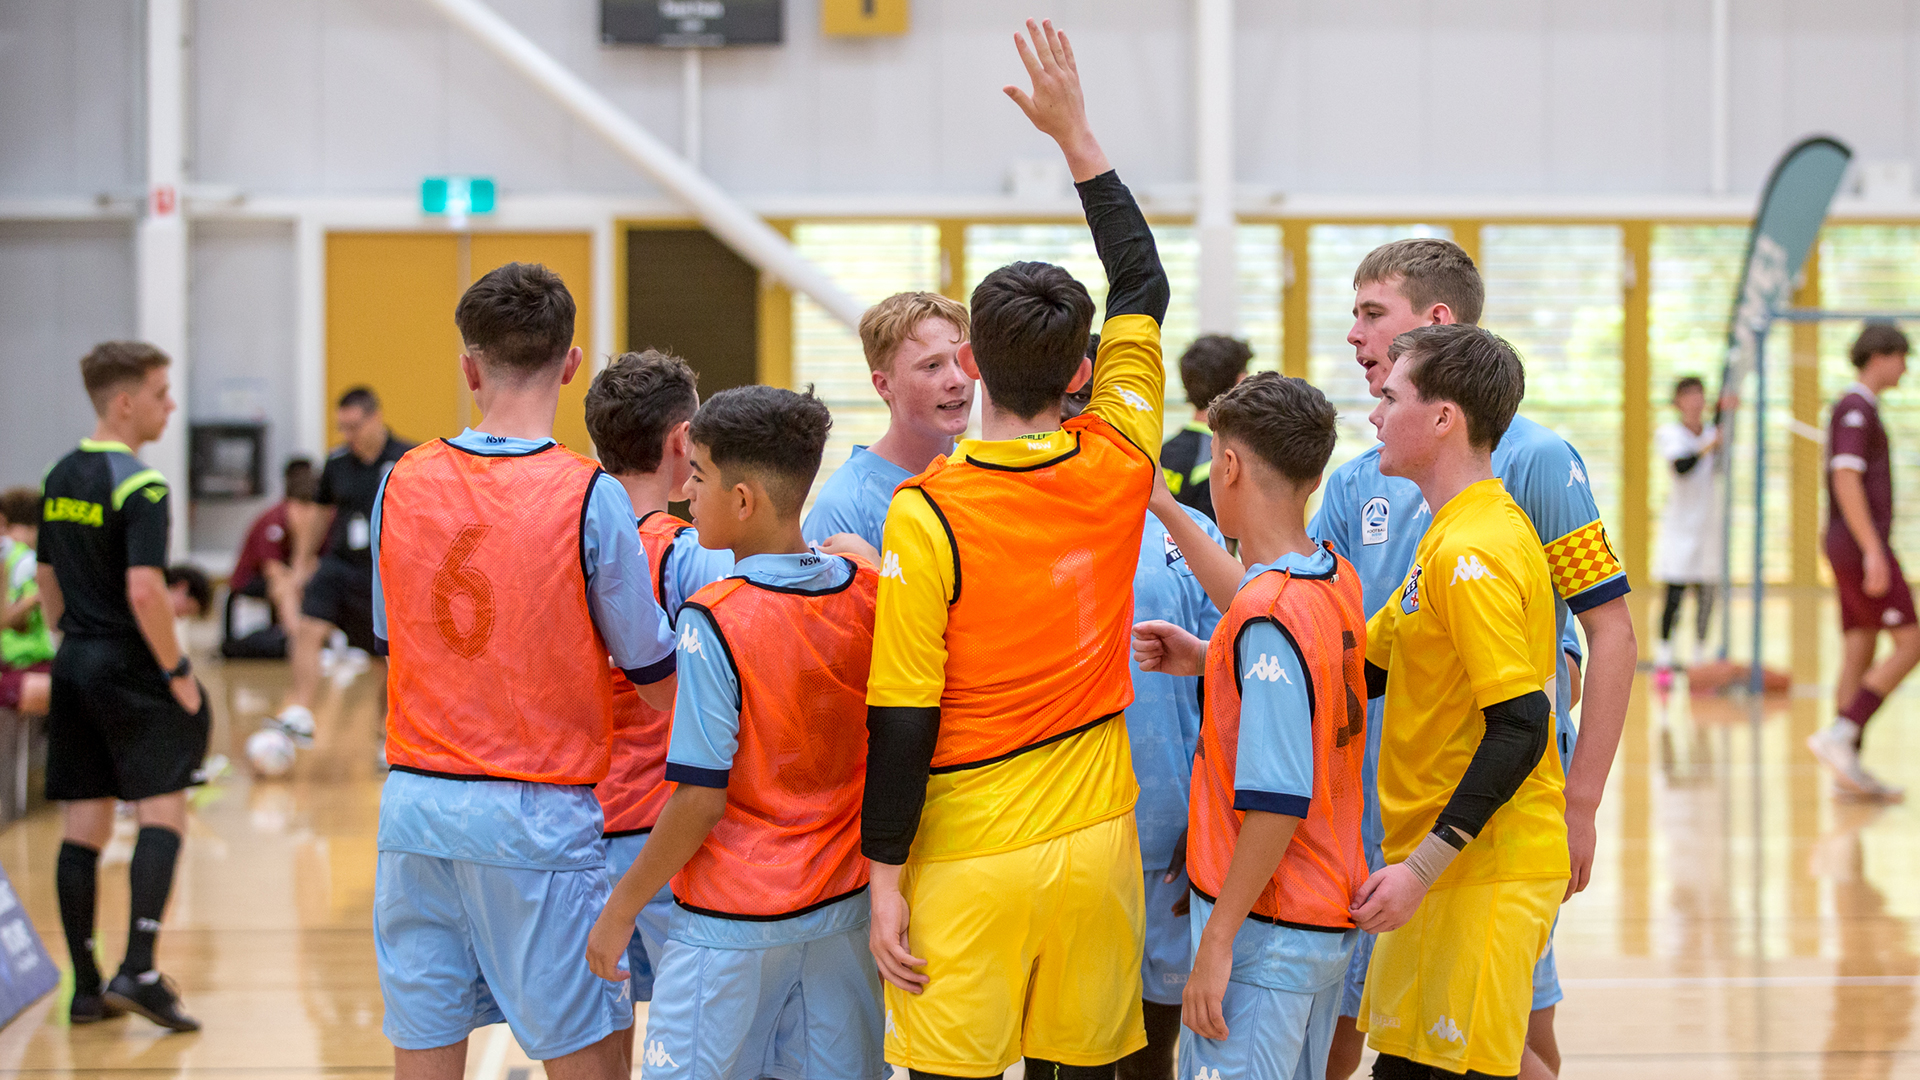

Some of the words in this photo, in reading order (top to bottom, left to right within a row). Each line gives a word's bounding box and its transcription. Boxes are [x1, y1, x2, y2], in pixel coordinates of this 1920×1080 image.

[1027, 441, 1051, 451] NSW
[800, 555, 820, 567] NSW
[431, 523, 496, 661] 6
[1404, 578, 1417, 596] NS
